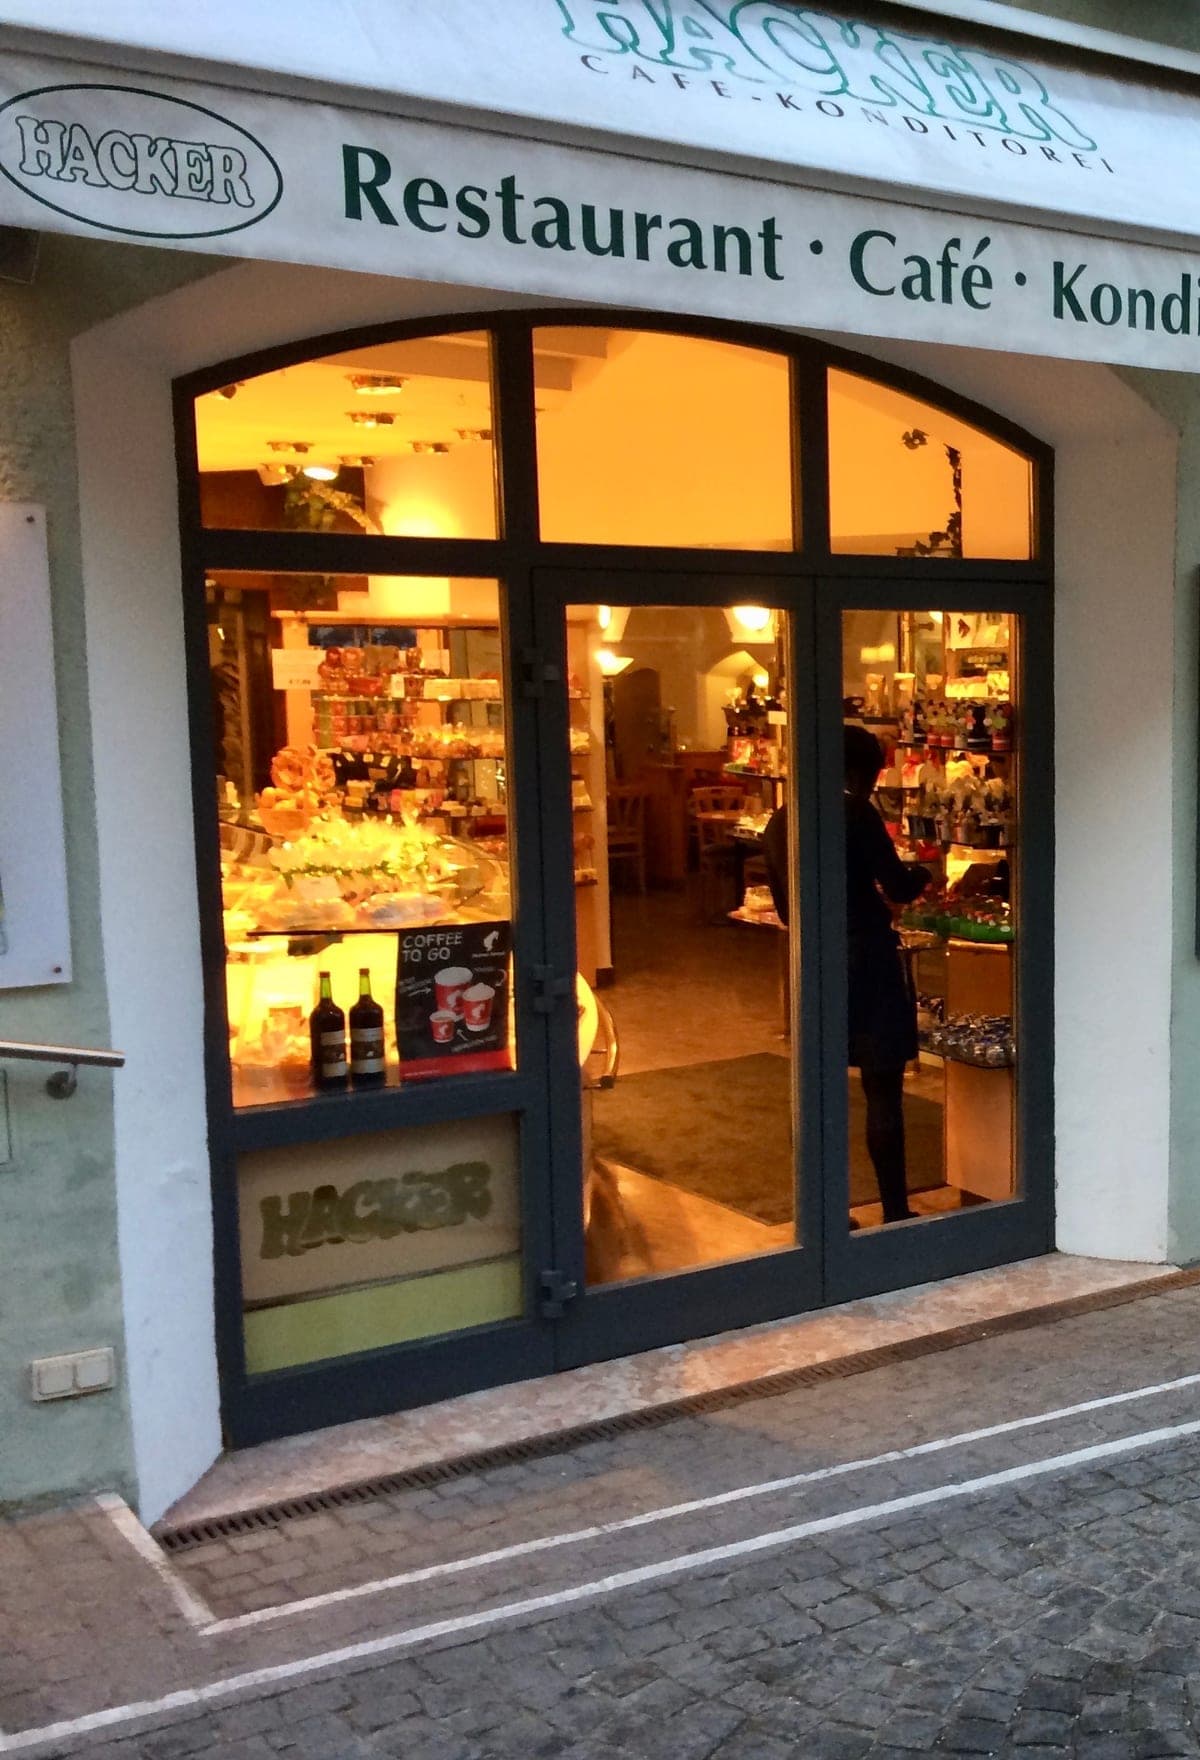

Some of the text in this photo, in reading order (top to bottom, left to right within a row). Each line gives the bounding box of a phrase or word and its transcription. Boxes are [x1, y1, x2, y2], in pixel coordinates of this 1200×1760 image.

[17, 116, 255, 208] HACKER
[342, 144, 785, 281] Restaurant
[849, 229, 993, 310] Café
[403, 932, 463, 949] COFFEE
[403, 946, 451, 962] TO GO
